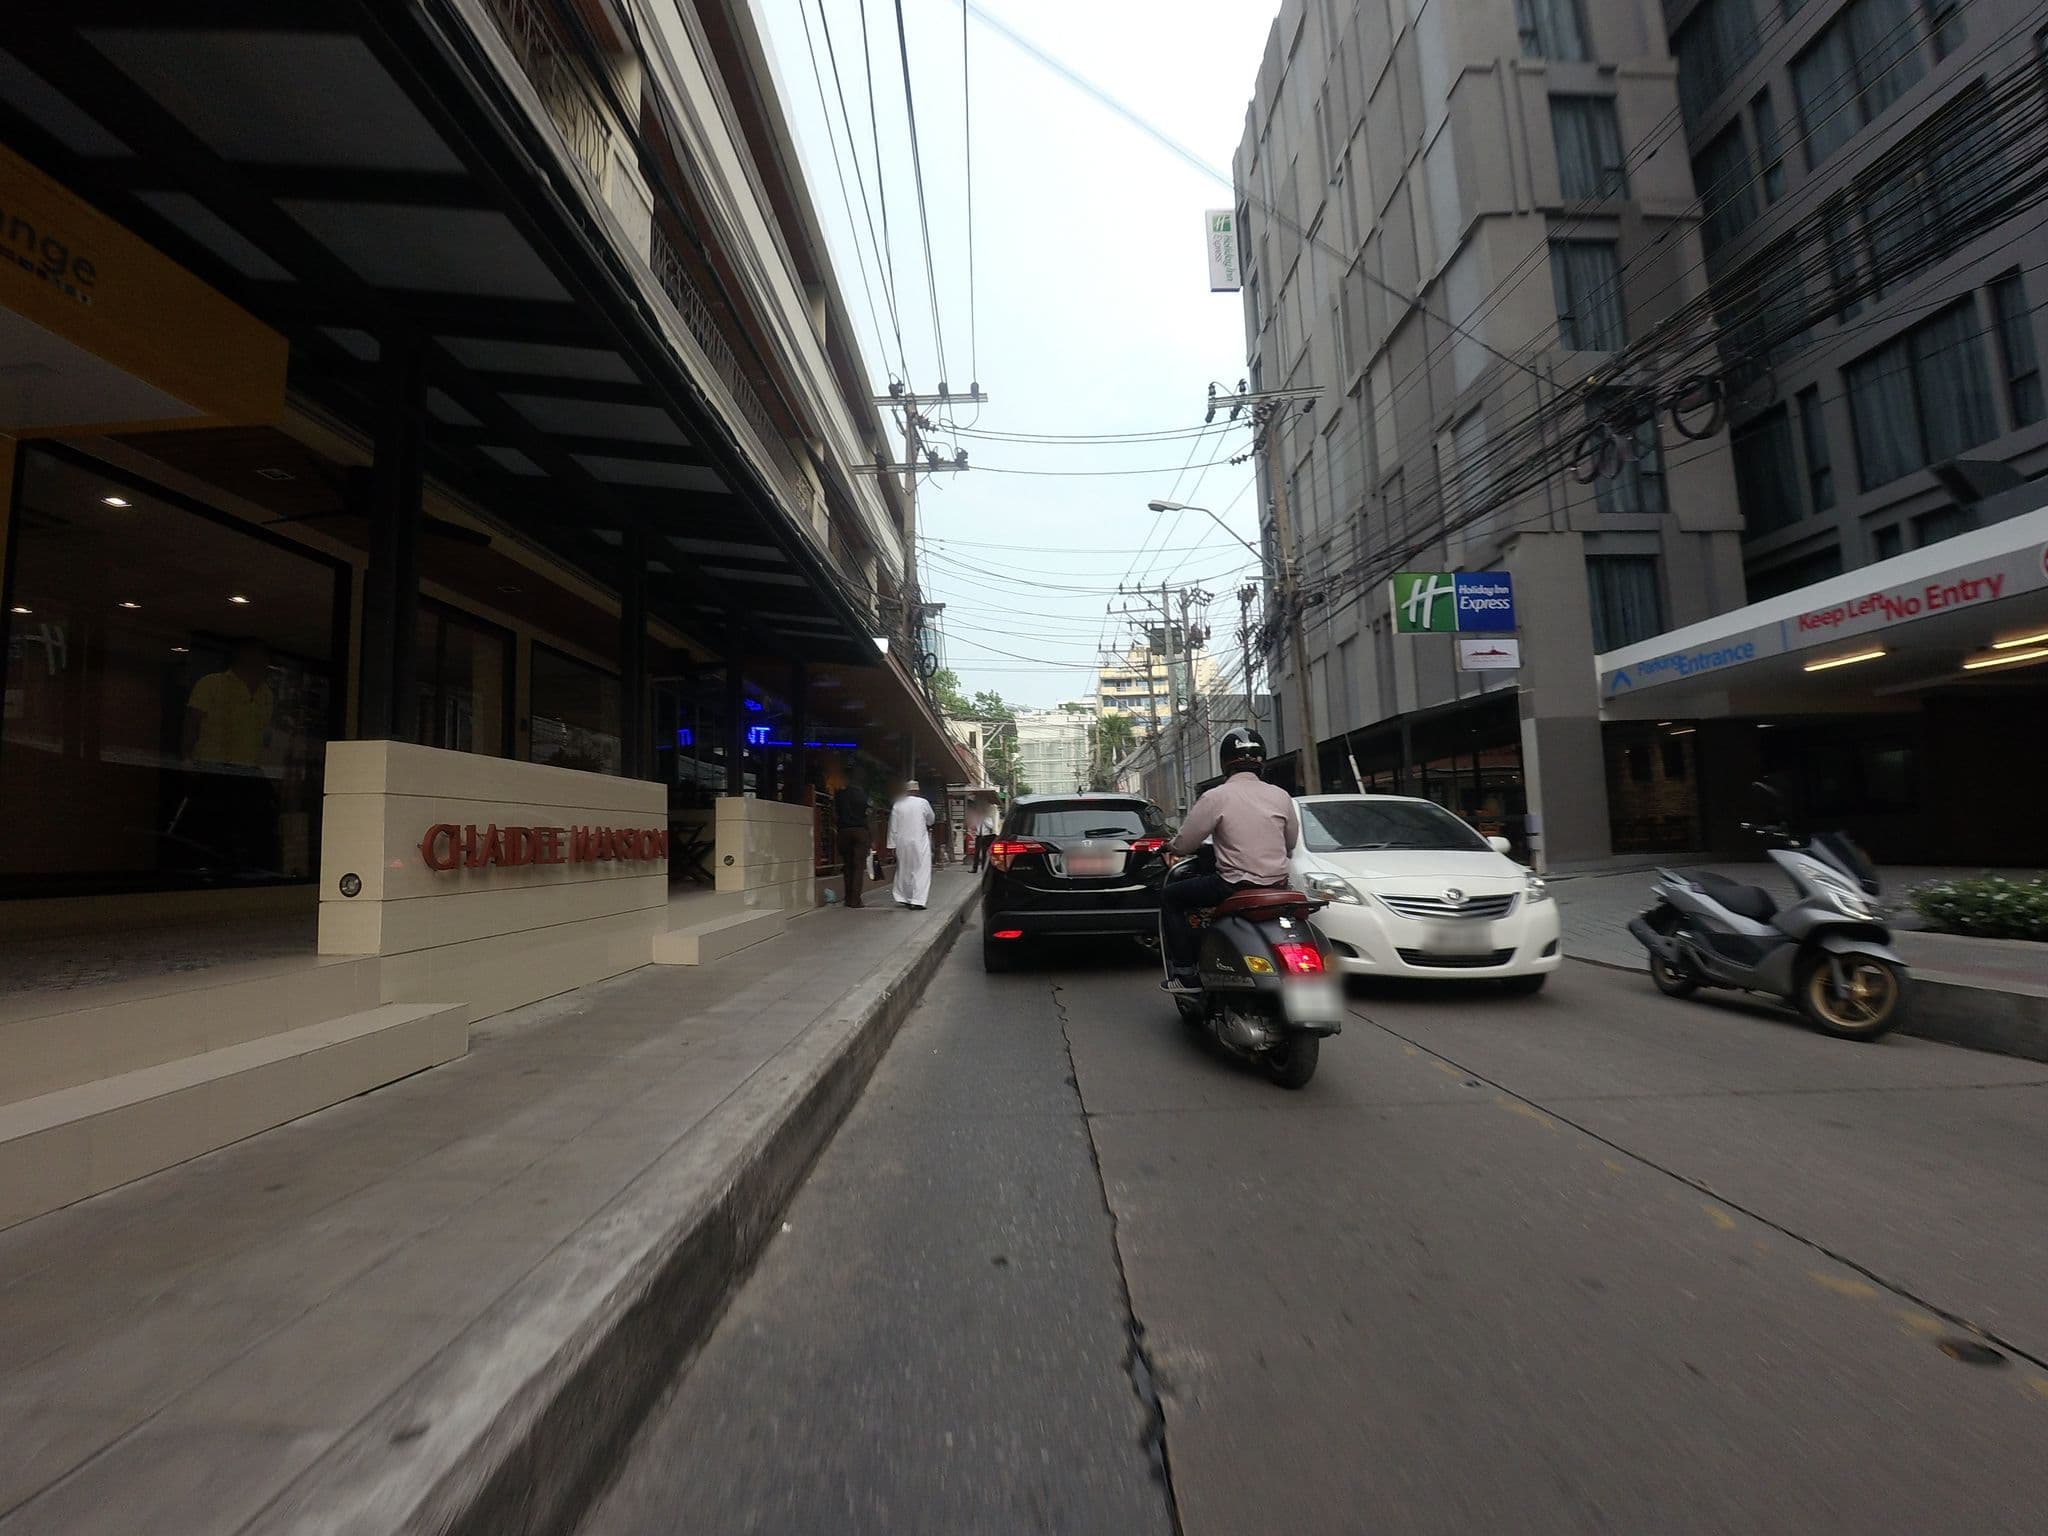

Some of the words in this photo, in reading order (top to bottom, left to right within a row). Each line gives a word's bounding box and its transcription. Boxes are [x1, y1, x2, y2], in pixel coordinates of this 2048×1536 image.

[0, 207, 96, 286] nge
[1459, 584, 1493, 596] Holiday
[1494, 584, 1509, 594] Inn
[1460, 596, 1510, 613] Express
[1885, 595, 1921, 621] No
[1924, 574, 2006, 611] Entry
[1798, 606, 1844, 632] Keep
[1846, 591, 1886, 618] Left
[1679, 642, 1755, 676] Entrance
[422, 823, 567, 871] CHAIDEE
[567, 825, 668, 862] MANSION
